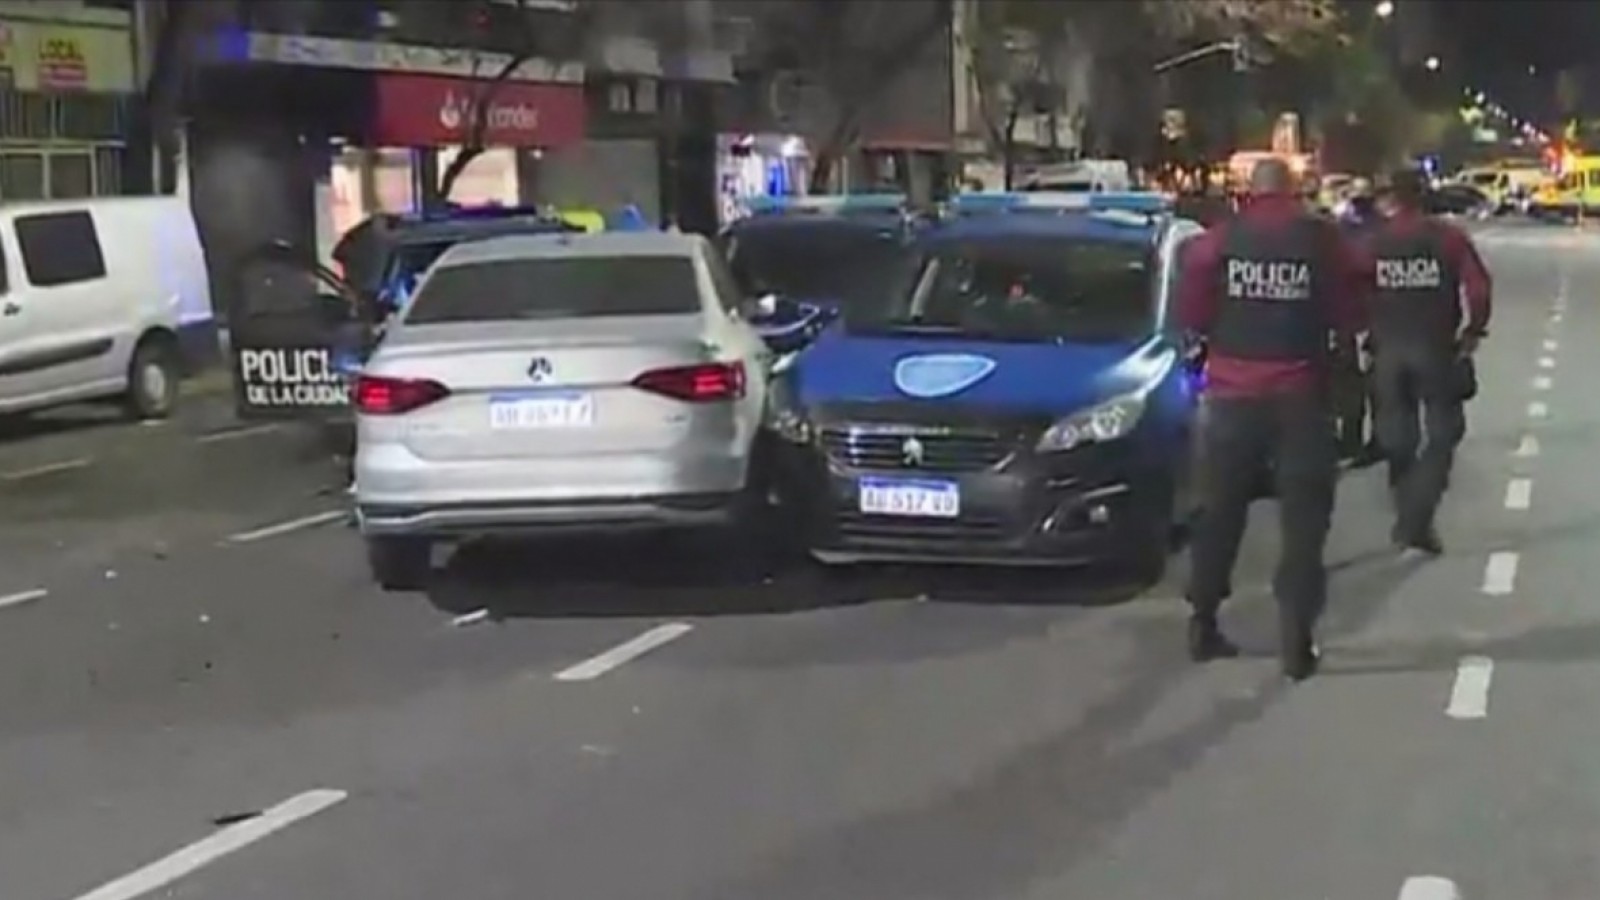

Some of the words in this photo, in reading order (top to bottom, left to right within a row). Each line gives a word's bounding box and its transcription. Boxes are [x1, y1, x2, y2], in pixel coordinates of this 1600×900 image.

[38, 38, 84, 60] LOCAL
[1228, 259, 1309, 285] POLICIA
[1376, 258, 1440, 278] POLICIA
[241, 348, 338, 382] POLICI
[247, 385, 269, 404] DE
[271, 384, 293, 404] LA
